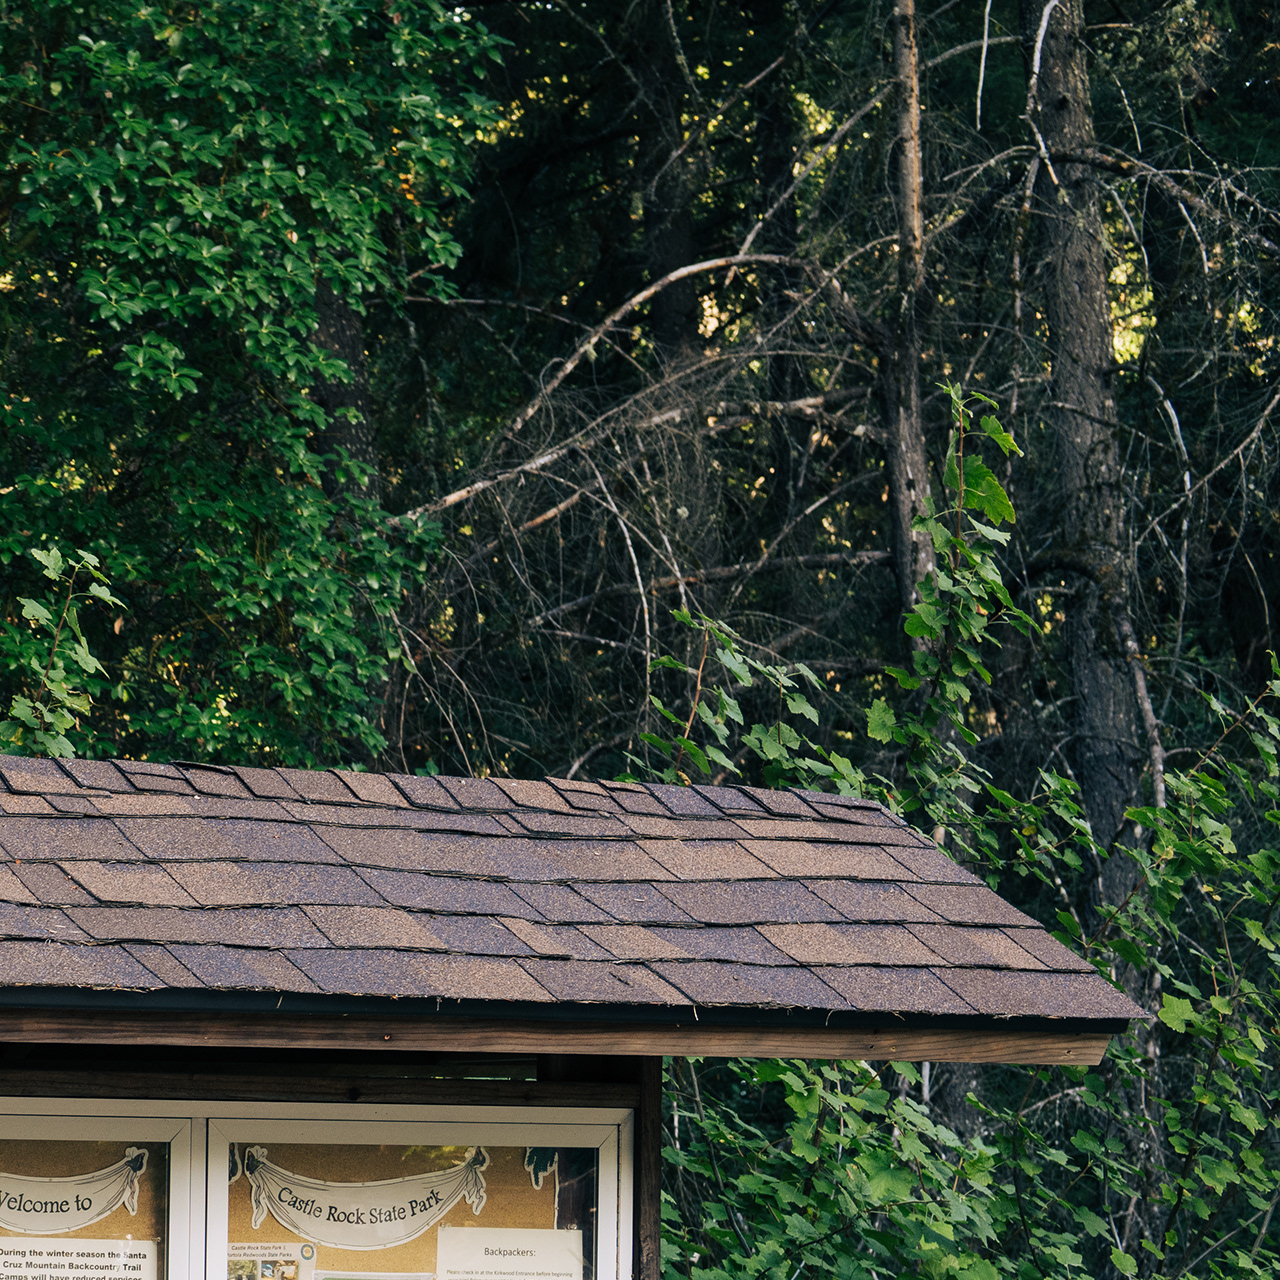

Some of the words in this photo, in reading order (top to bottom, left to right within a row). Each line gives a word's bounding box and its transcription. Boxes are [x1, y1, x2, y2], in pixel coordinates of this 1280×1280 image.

[74, 1194, 93, 1212] to
[277, 1187, 323, 1218] Castle
[326, 1205, 366, 1224] Rock
[369, 1206, 406, 1224] State
[408, 1189, 444, 1216] Park
[29, 1249, 44, 1257] the
[45, 1249, 74, 1258] winter
[75, 1251, 106, 1259] season
[107, 1251, 121, 1259] the
[123, 1252, 147, 1260] Santa
[484, 1247, 536, 1258] Backpackers:
[2, 1260, 23, 1269] Cruz
[25, 1261, 66, 1270] Mountain
[122, 1263, 142, 1272] Trail
[30, 1273, 47, 1280] will
